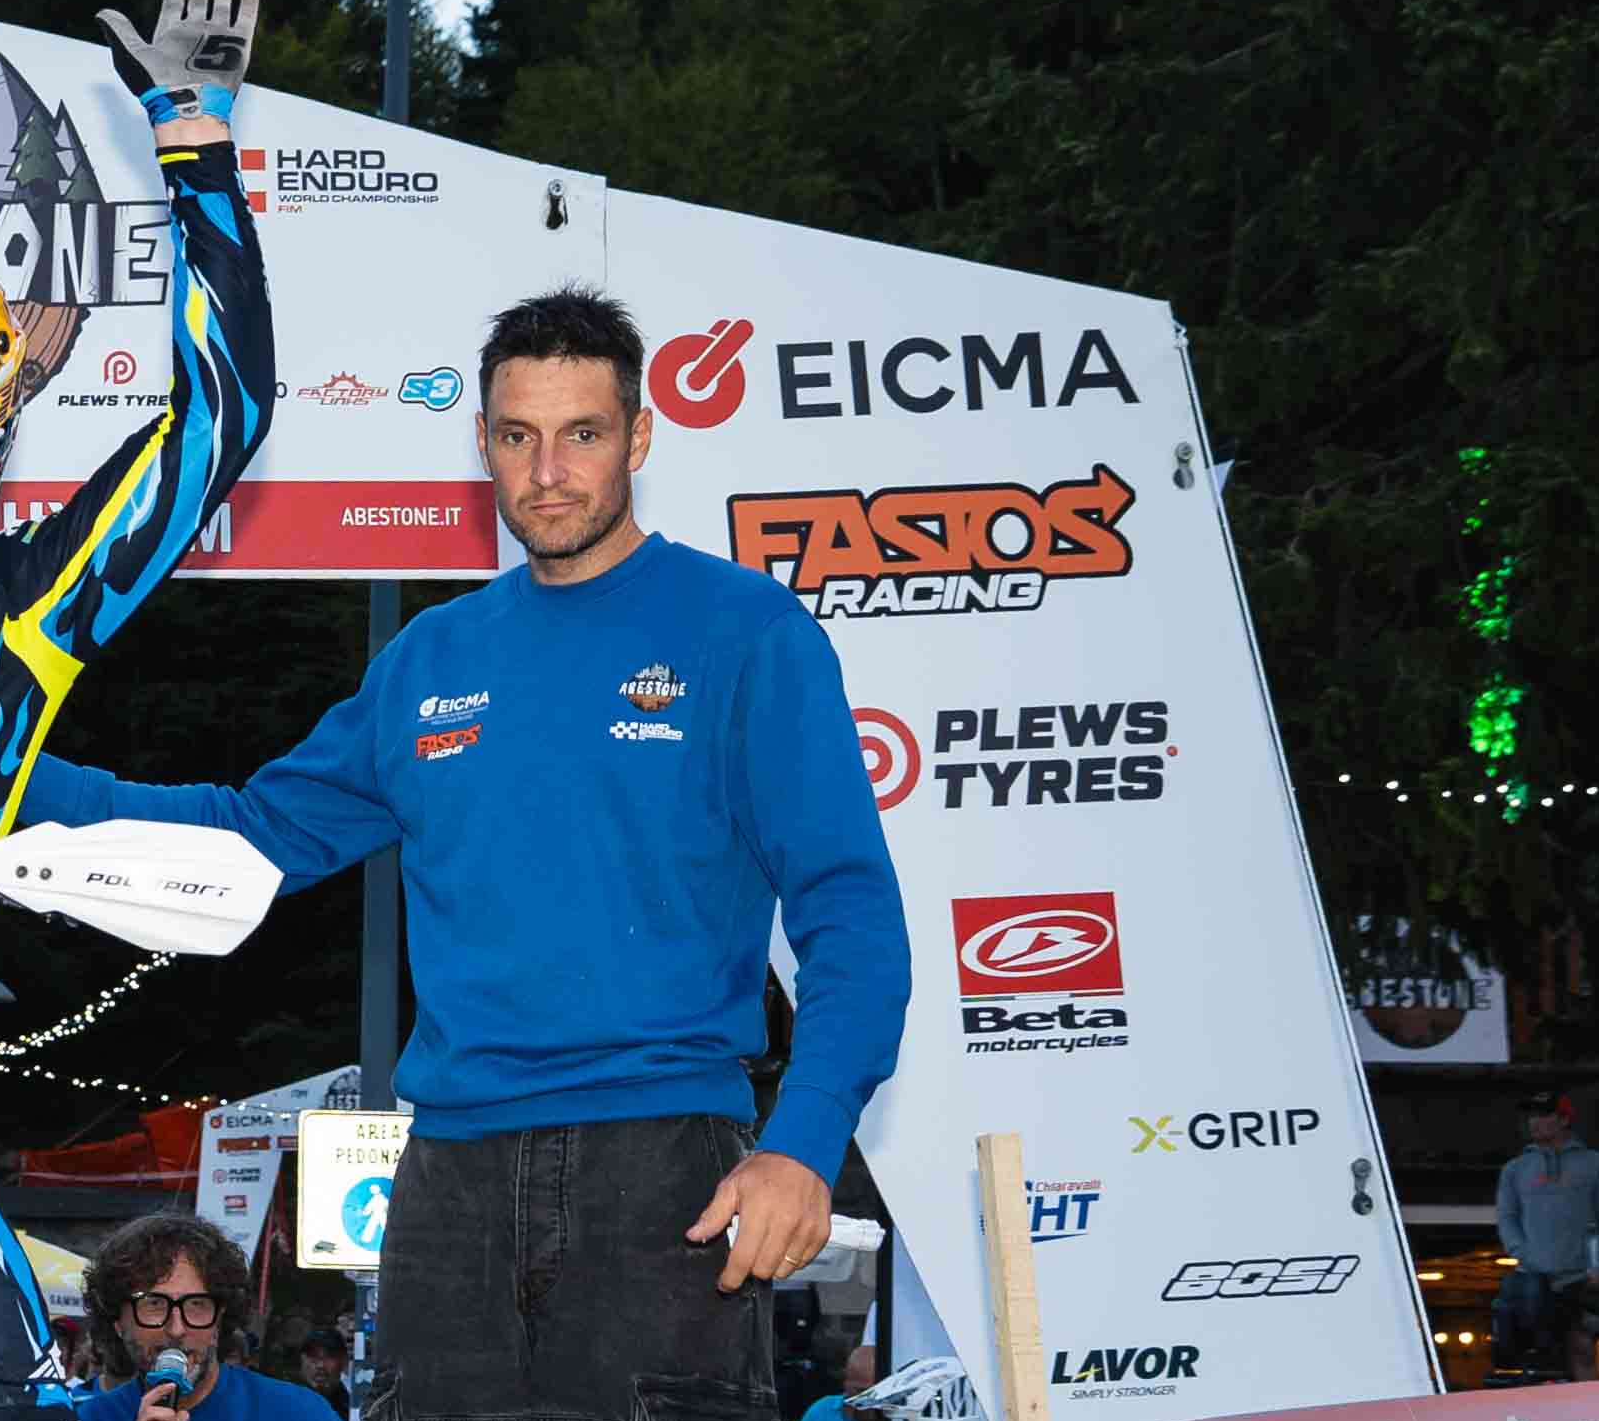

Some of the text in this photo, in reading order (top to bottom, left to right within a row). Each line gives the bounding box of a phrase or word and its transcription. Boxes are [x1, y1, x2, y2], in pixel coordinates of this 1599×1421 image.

[277, 150, 385, 170] HARD
[277, 172, 439, 192] ENDURO
[278, 194, 439, 204] WORLD CHAMPIONSHIP
[776, 329, 1141, 420] EICMA
[58, 394, 170, 406] PLEWS TYRE
[341, 507, 461, 527] ABESTONE.IT
[813, 571, 1044, 620] RACING
[619, 681, 687, 697] ABESTONE
[438, 691, 491, 715] EICMA
[934, 701, 1168, 753] PLEWS
[934, 754, 1164, 809] TYRES
[961, 1004, 1128, 1034] Beta
[967, 1034, 1129, 1054] motorcycles
[226, 1115, 273, 1129] EICMA
[356, 1124, 402, 1139] AREA
[336, 1148, 402, 1164] PEDONA
[1027, 1192, 1100, 1235] HT
[1052, 1345, 1200, 1385] LAVOR
[1068, 1385, 1177, 1401] SIMPLY STRONGER
